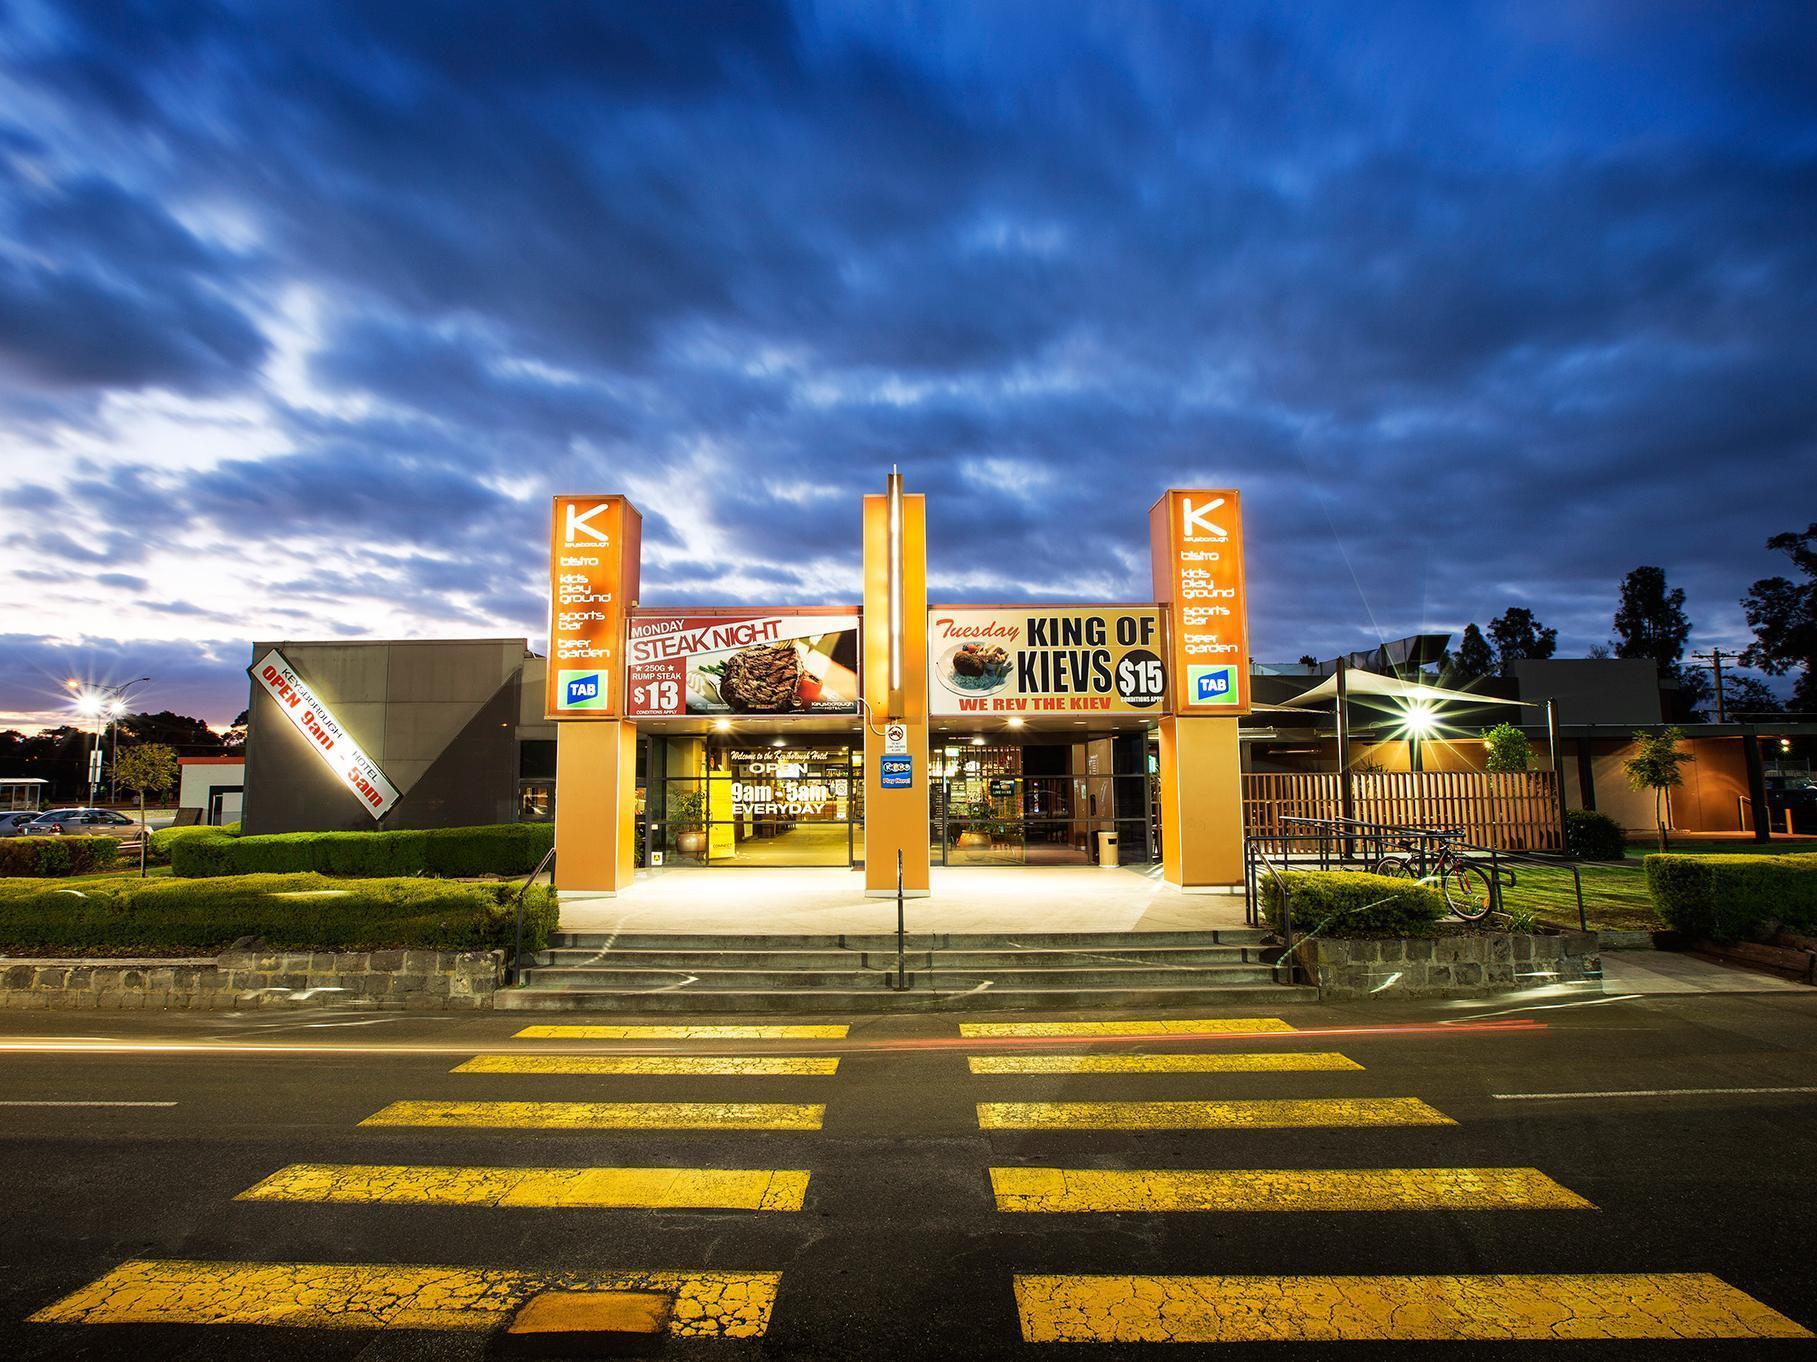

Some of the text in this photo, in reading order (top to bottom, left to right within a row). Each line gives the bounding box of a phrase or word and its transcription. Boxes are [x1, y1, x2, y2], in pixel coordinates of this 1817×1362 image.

[1183, 498, 1227, 536] K
[566, 504, 608, 543] K
[560, 556, 599, 566] bistro
[1181, 551, 1219, 560] bistro
[1182, 567, 1210, 578] kids
[560, 574, 588, 583] kids
[1182, 578, 1214, 590] play
[560, 584, 591, 594] play
[1183, 588, 1235, 599] ground
[560, 593, 611, 604] ground
[559, 611, 605, 621] sports
[1183, 606, 1230, 617] sports
[559, 621, 583, 630] bar
[1184, 616, 1208, 625] bar
[632, 619, 685, 638] MONDAY
[936, 618, 1020, 642] Tuesday
[1027, 616, 1155, 646] KING OF
[558, 638, 591, 648] beer
[633, 620, 782, 661] STEAK NIGHT
[1184, 633, 1217, 643] beer
[558, 648, 610, 659] garden
[1185, 643, 1238, 654] garden
[1017, 649, 1113, 693] KIEVS
[1119, 658, 1163, 696] $15
[570, 684, 596, 696] TAB
[1200, 679, 1227, 691] TAB
[634, 681, 679, 710] $13
[959, 697, 1112, 711] WE REV THE KIEV
[282, 668, 378, 782] KEYSBOROUGH HOTEL
[262, 665, 301, 708] OPEN
[301, 710, 335, 750] 9am
[348, 767, 384, 808] 5am
[732, 783, 772, 802] 9am
[786, 782, 826, 802] 5am
[732, 804, 825, 814] EVERYDAY
